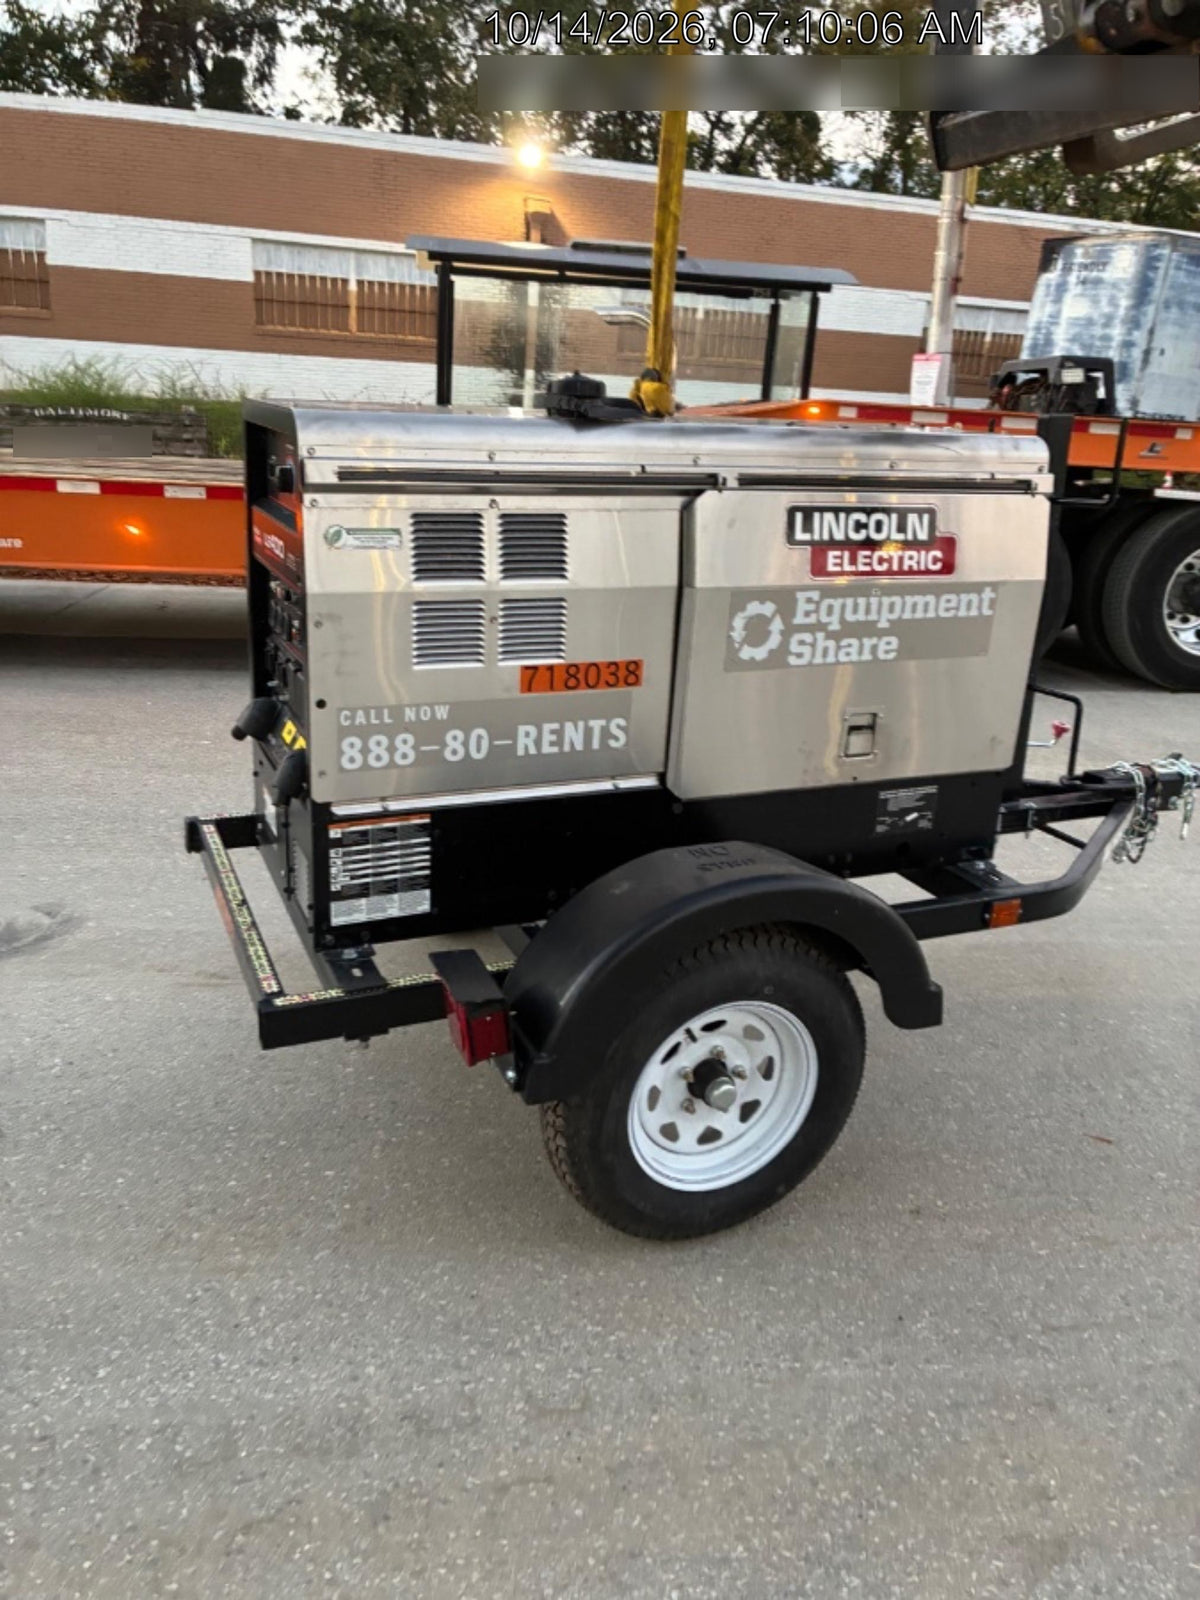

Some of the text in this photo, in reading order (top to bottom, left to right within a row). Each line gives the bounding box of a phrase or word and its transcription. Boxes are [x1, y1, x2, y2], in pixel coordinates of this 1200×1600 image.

[794, 511, 929, 541] LINCOLN
[826, 550, 943, 572] ELECTRIC
[792, 587, 997, 631] Equipment
[787, 632, 900, 667] Share
[523, 660, 640, 692] 718038
[340, 705, 450, 726] CALL NOW
[340, 718, 628, 770] 888-80-RENTS
